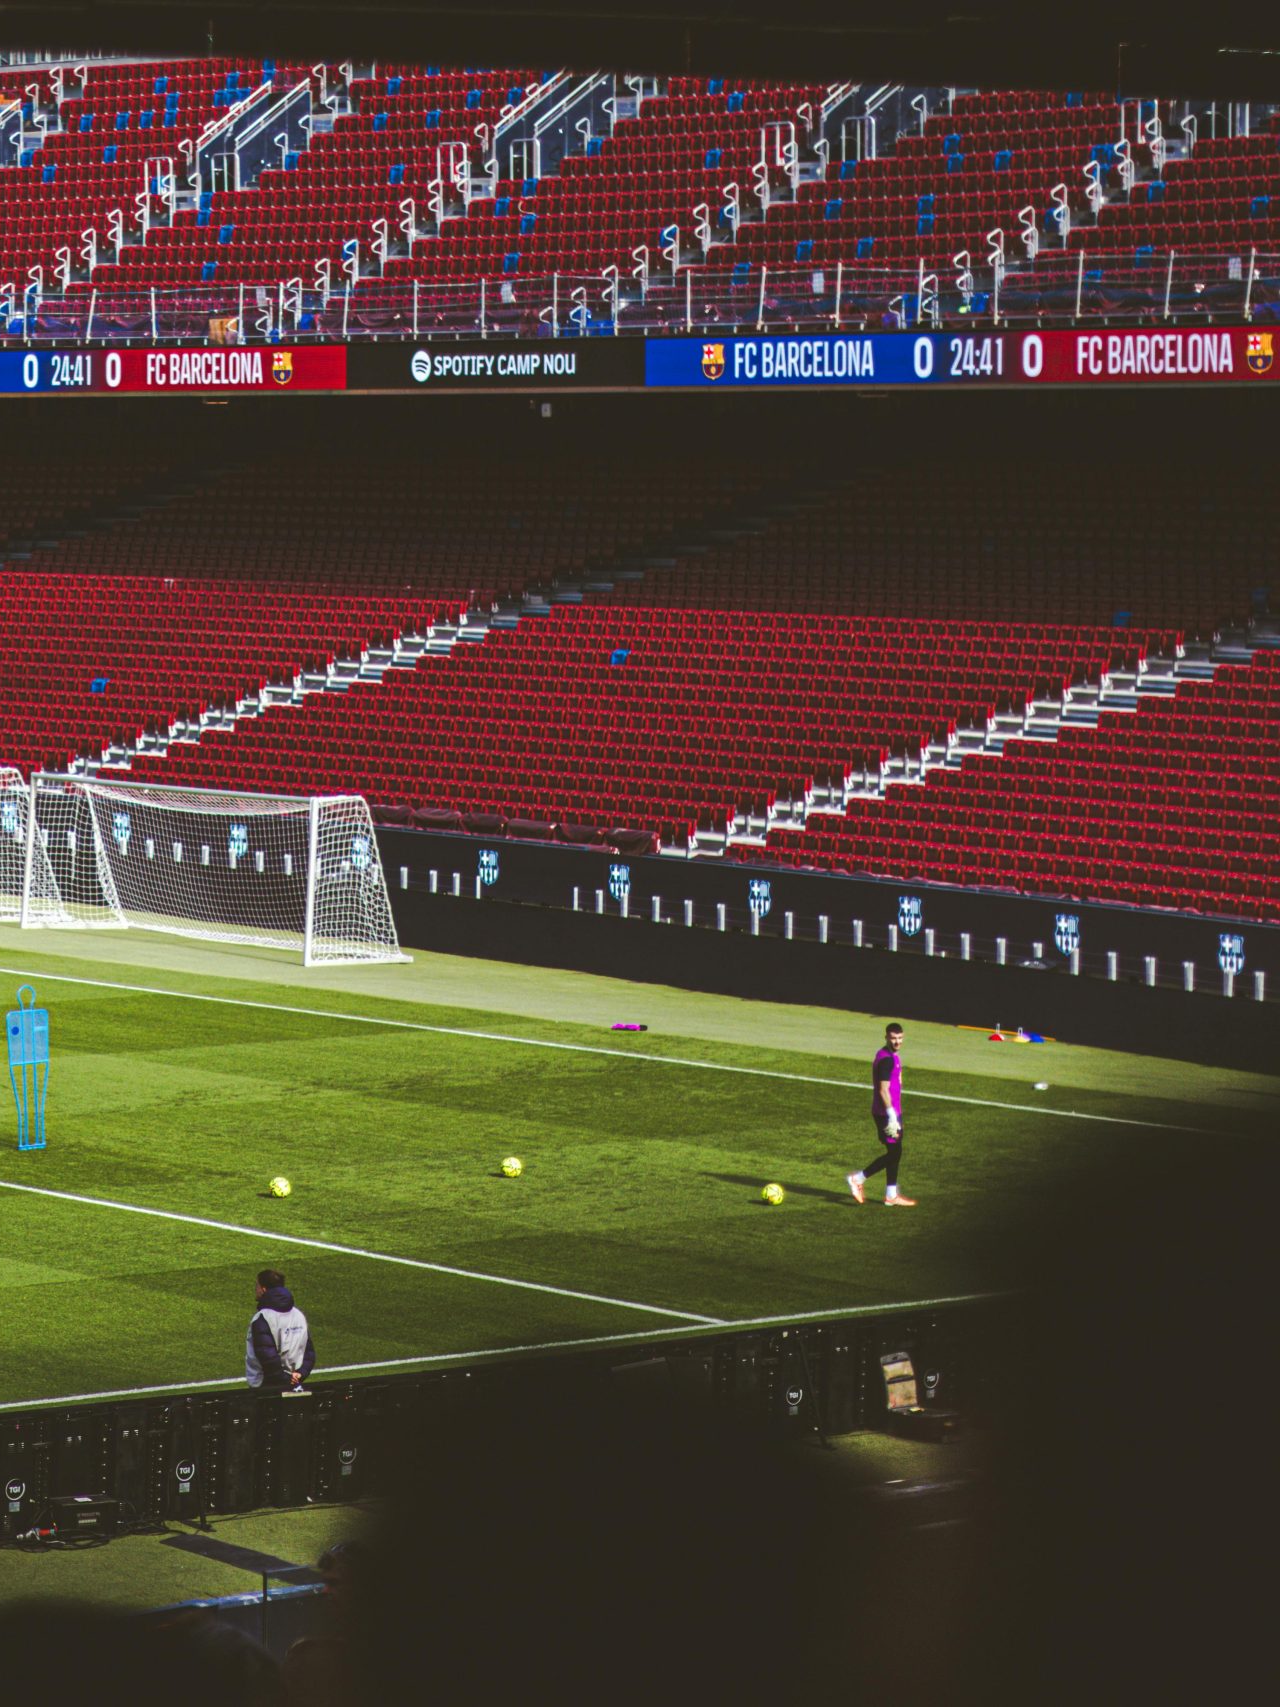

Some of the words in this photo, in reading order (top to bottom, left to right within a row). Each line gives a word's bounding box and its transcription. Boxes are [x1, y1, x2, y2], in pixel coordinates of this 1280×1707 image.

[22, 353, 38, 389] 0
[51, 355, 91, 386] 24:41
[105, 352, 121, 387] 0
[146, 353, 166, 385] FC
[169, 352, 263, 385] BARCELONA
[433, 354, 494, 376] SPOTIFY
[497, 353, 540, 376] CAMP
[543, 353, 575, 375] NOU
[734, 342, 757, 379] FC
[761, 340, 874, 378] BARCELONA
[913, 336, 933, 379] 0
[950, 337, 1003, 376] 24:41
[1022, 334, 1043, 378] 0
[1077, 335, 1102, 375] FC
[1107, 333, 1233, 375] BARCELONA
[9, 1486, 20, 1494] TGI
